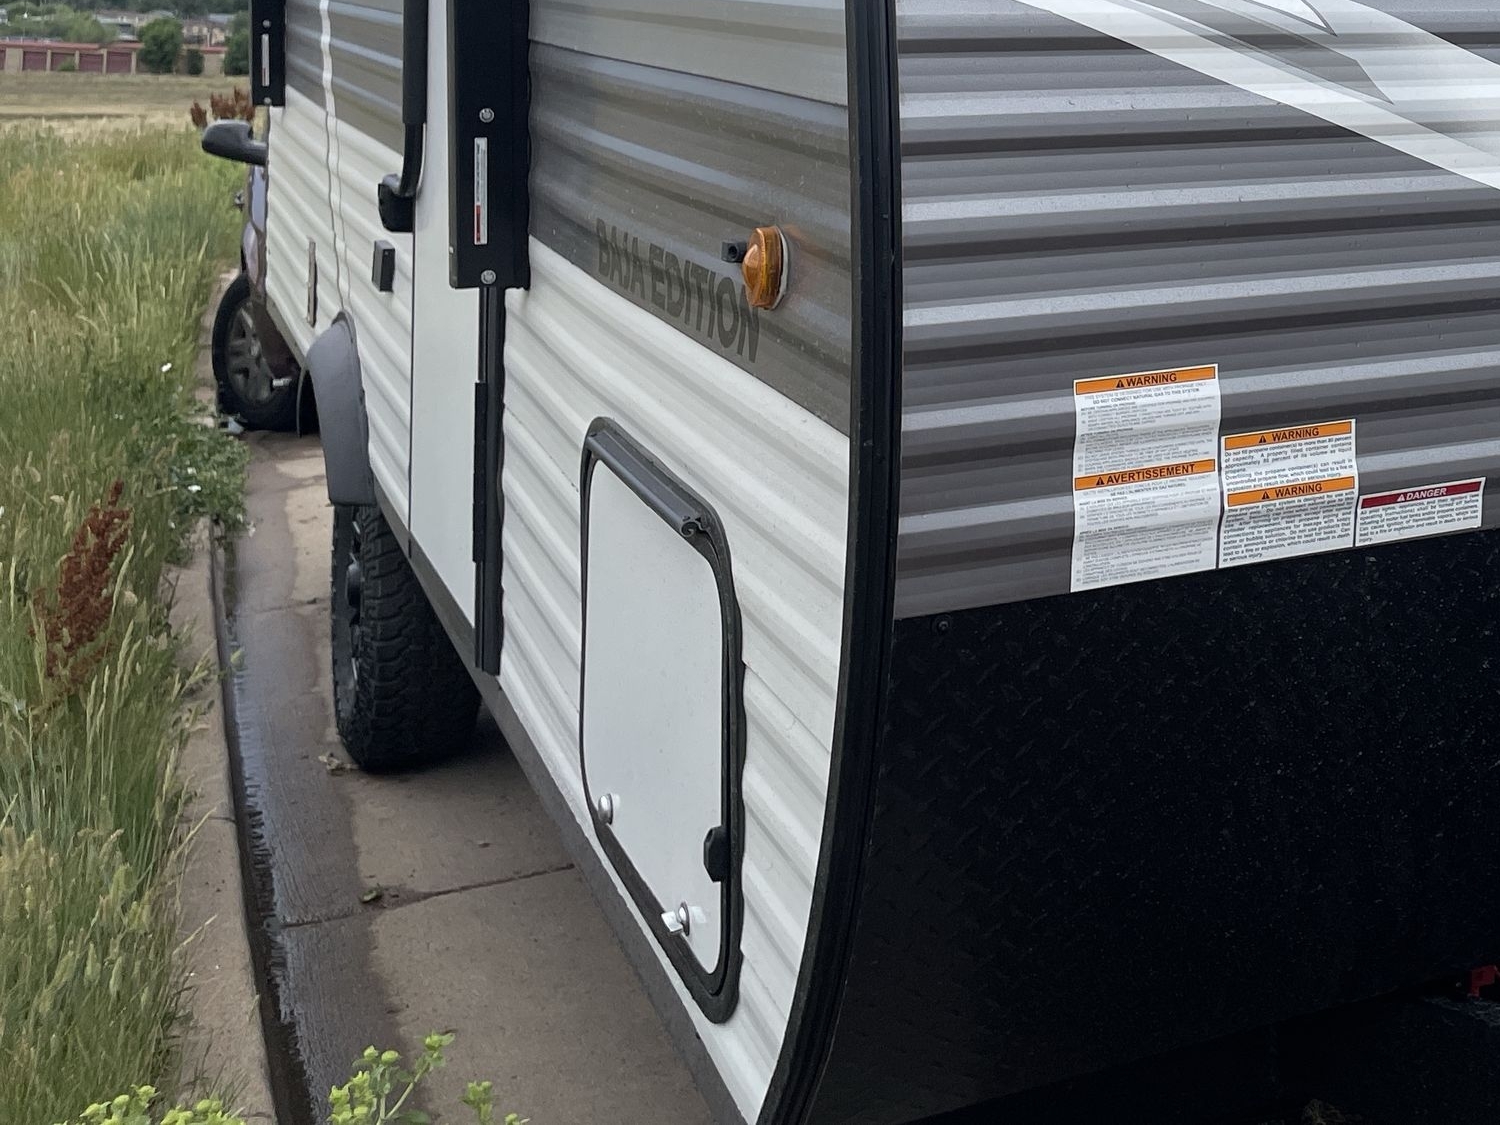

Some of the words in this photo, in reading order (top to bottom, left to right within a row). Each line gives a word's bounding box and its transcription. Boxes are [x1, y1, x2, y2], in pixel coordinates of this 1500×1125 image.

[650, 243, 760, 364] EDITION
[1126, 373, 1177, 387] WARNING
[1272, 427, 1319, 441] WARNING
[1106, 464, 1195, 484] AVERTISSEMENT
[1275, 483, 1322, 497] WARNING
[1406, 487, 1447, 501] DANGER
